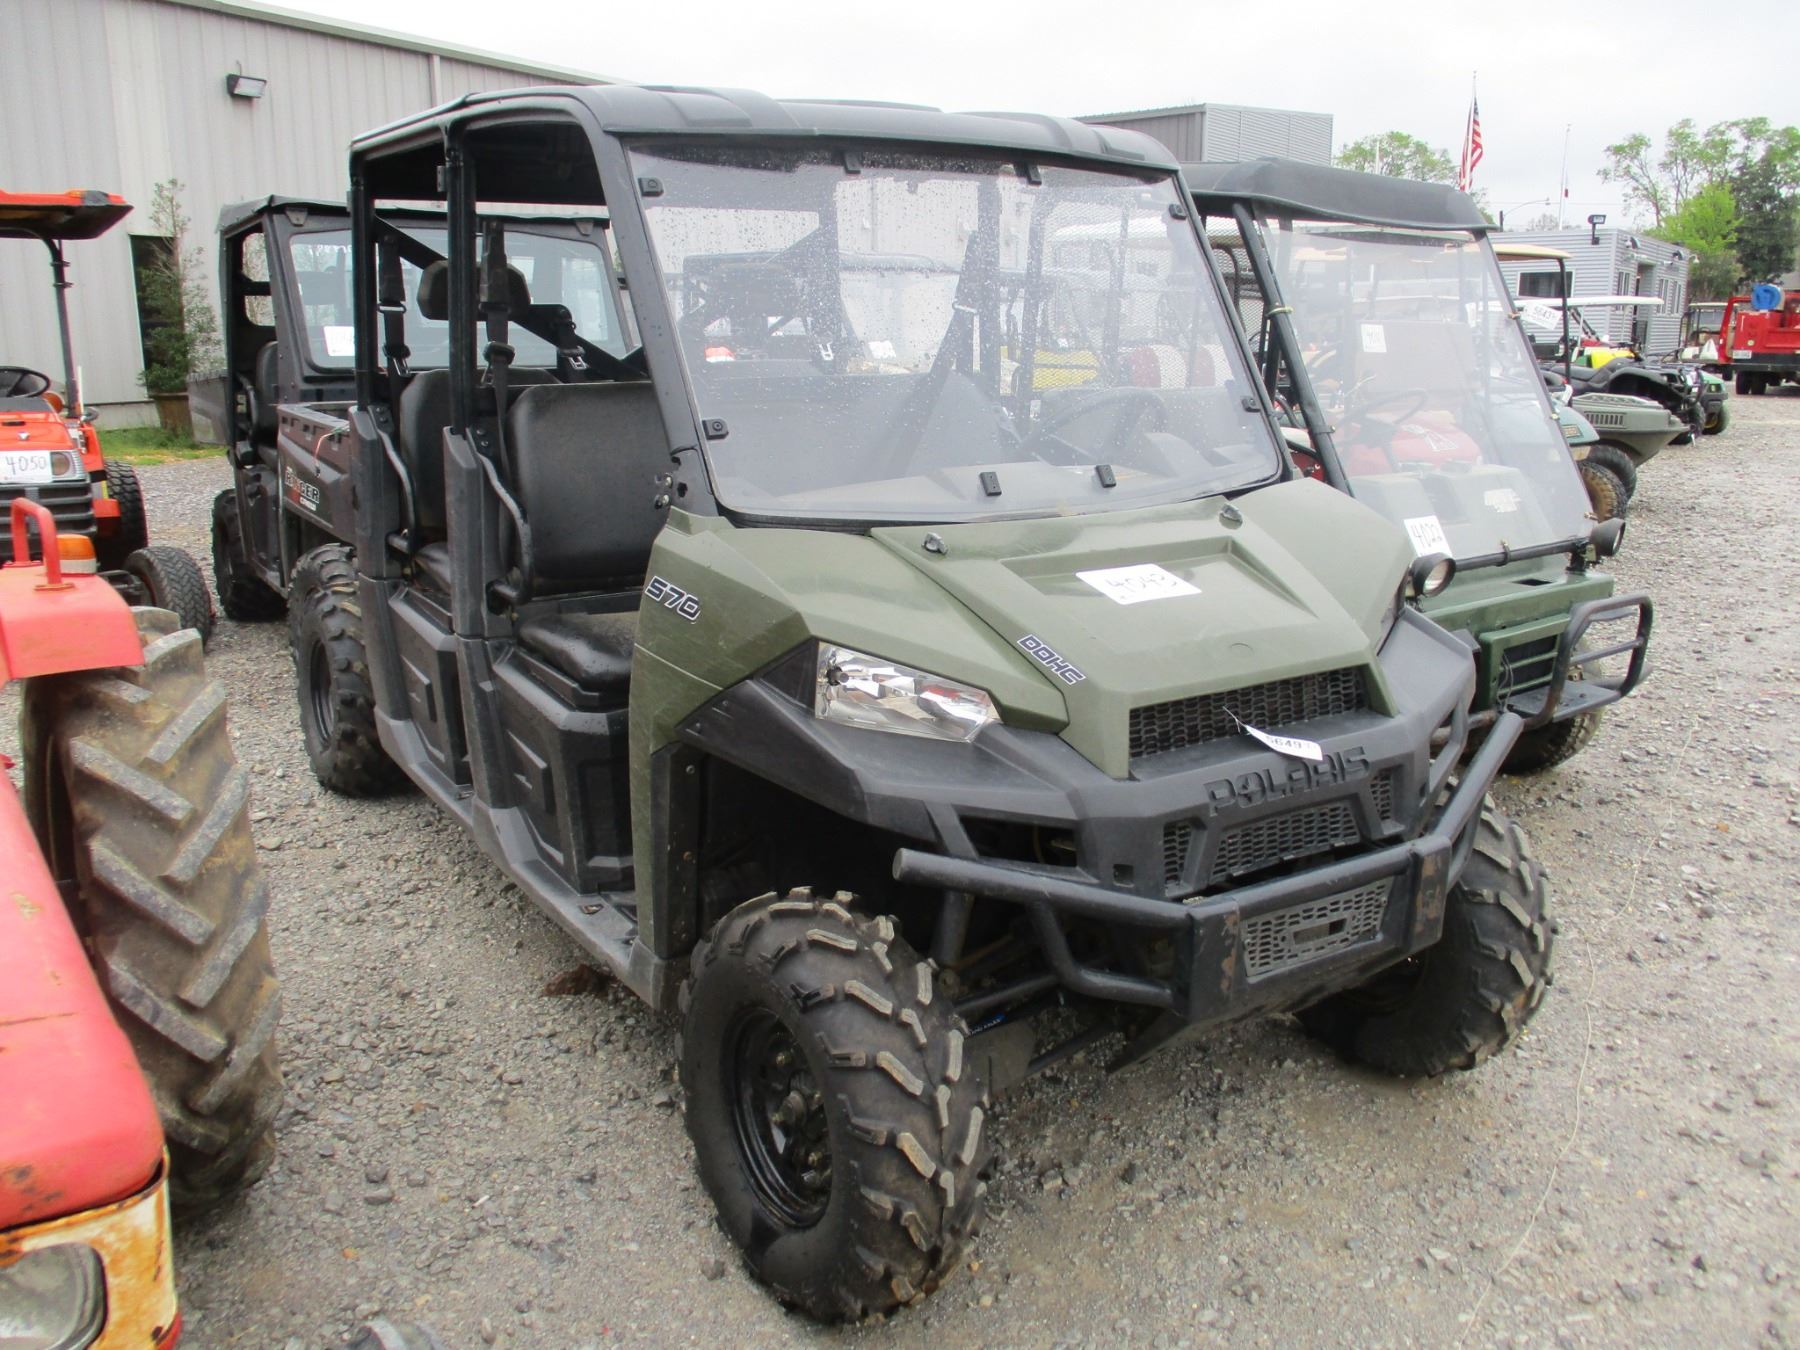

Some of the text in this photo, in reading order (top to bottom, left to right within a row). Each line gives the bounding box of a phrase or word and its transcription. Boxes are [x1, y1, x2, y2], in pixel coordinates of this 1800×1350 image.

[5, 455, 47, 475] 4050
[645, 576, 701, 621] 570
[1017, 634, 1087, 686] DOHC
[1203, 746, 1371, 817] POLARIS
